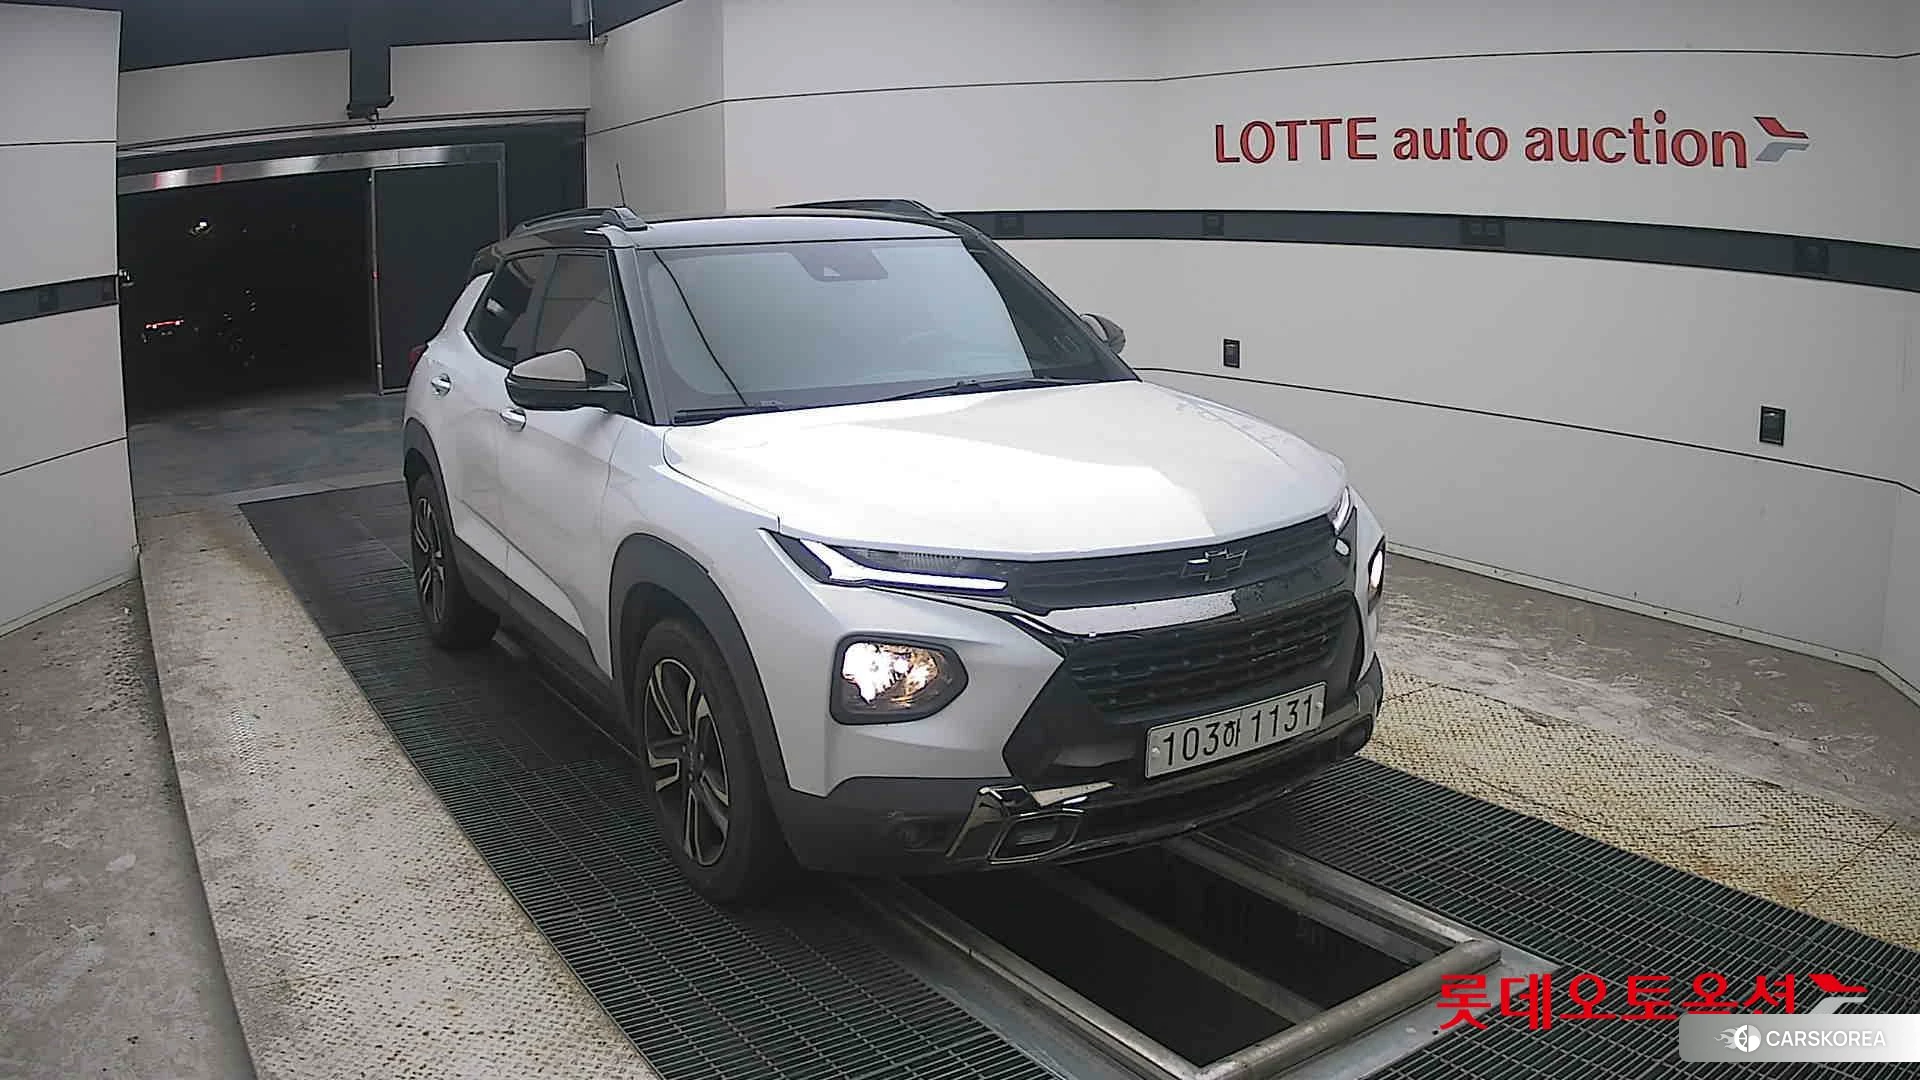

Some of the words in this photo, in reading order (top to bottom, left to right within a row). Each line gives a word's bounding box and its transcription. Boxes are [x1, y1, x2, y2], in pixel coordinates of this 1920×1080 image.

[1215, 117, 1377, 163] LOTTE
[1393, 117, 1509, 161] auto
[1524, 109, 1748, 168] auction
[1163, 718, 1241, 766] 103하
[1251, 694, 1313, 743] 1131
